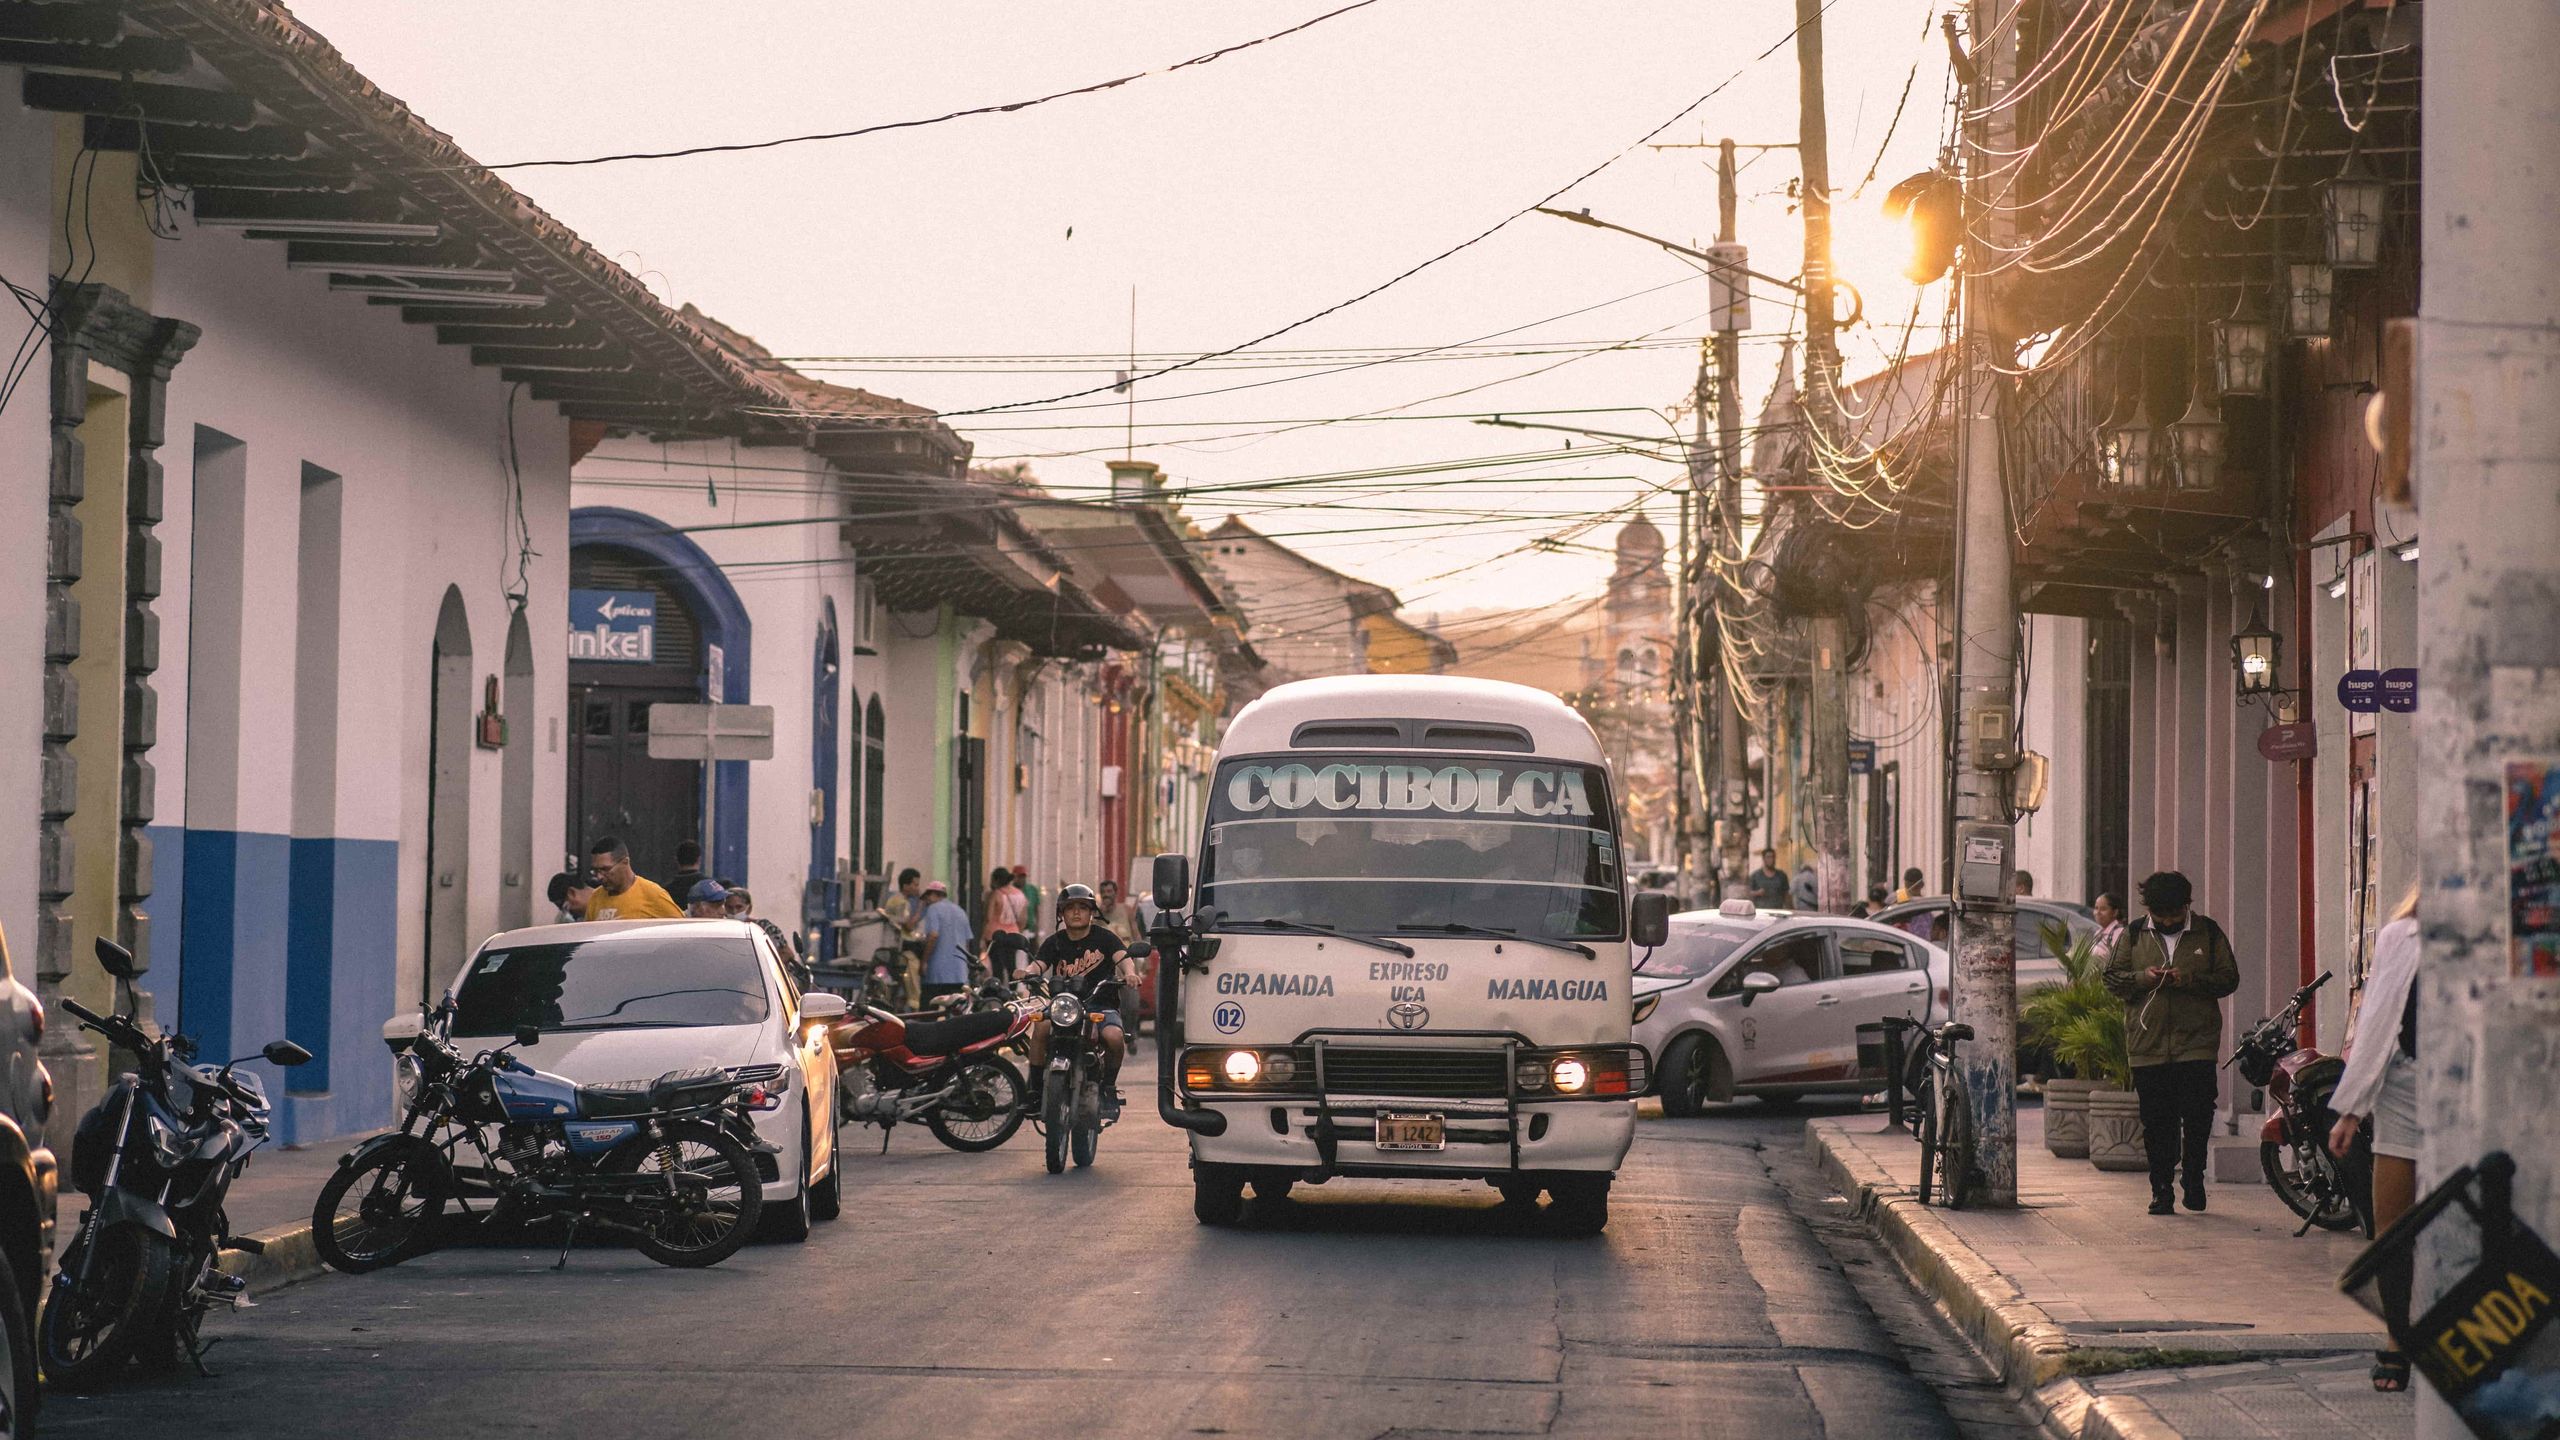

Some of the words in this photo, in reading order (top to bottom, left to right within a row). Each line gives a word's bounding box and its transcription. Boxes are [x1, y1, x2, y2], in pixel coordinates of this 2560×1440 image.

[569, 624, 652, 660] nkel
[2347, 680, 2374, 690] hugo
[2385, 680, 2413, 690] hugo
[1228, 763, 1593, 817] COCIBOLCA
[1056, 949, 1104, 977] Orioles
[1369, 962, 1449, 981] EXPRESO
[1216, 972, 1334, 997] GRANADA
[1391, 986, 1425, 1002] UCA
[1488, 979, 1607, 1001] MANAGUA
[1218, 1007, 1241, 1027] 02
[1404, 1127, 1433, 1141] 1242
